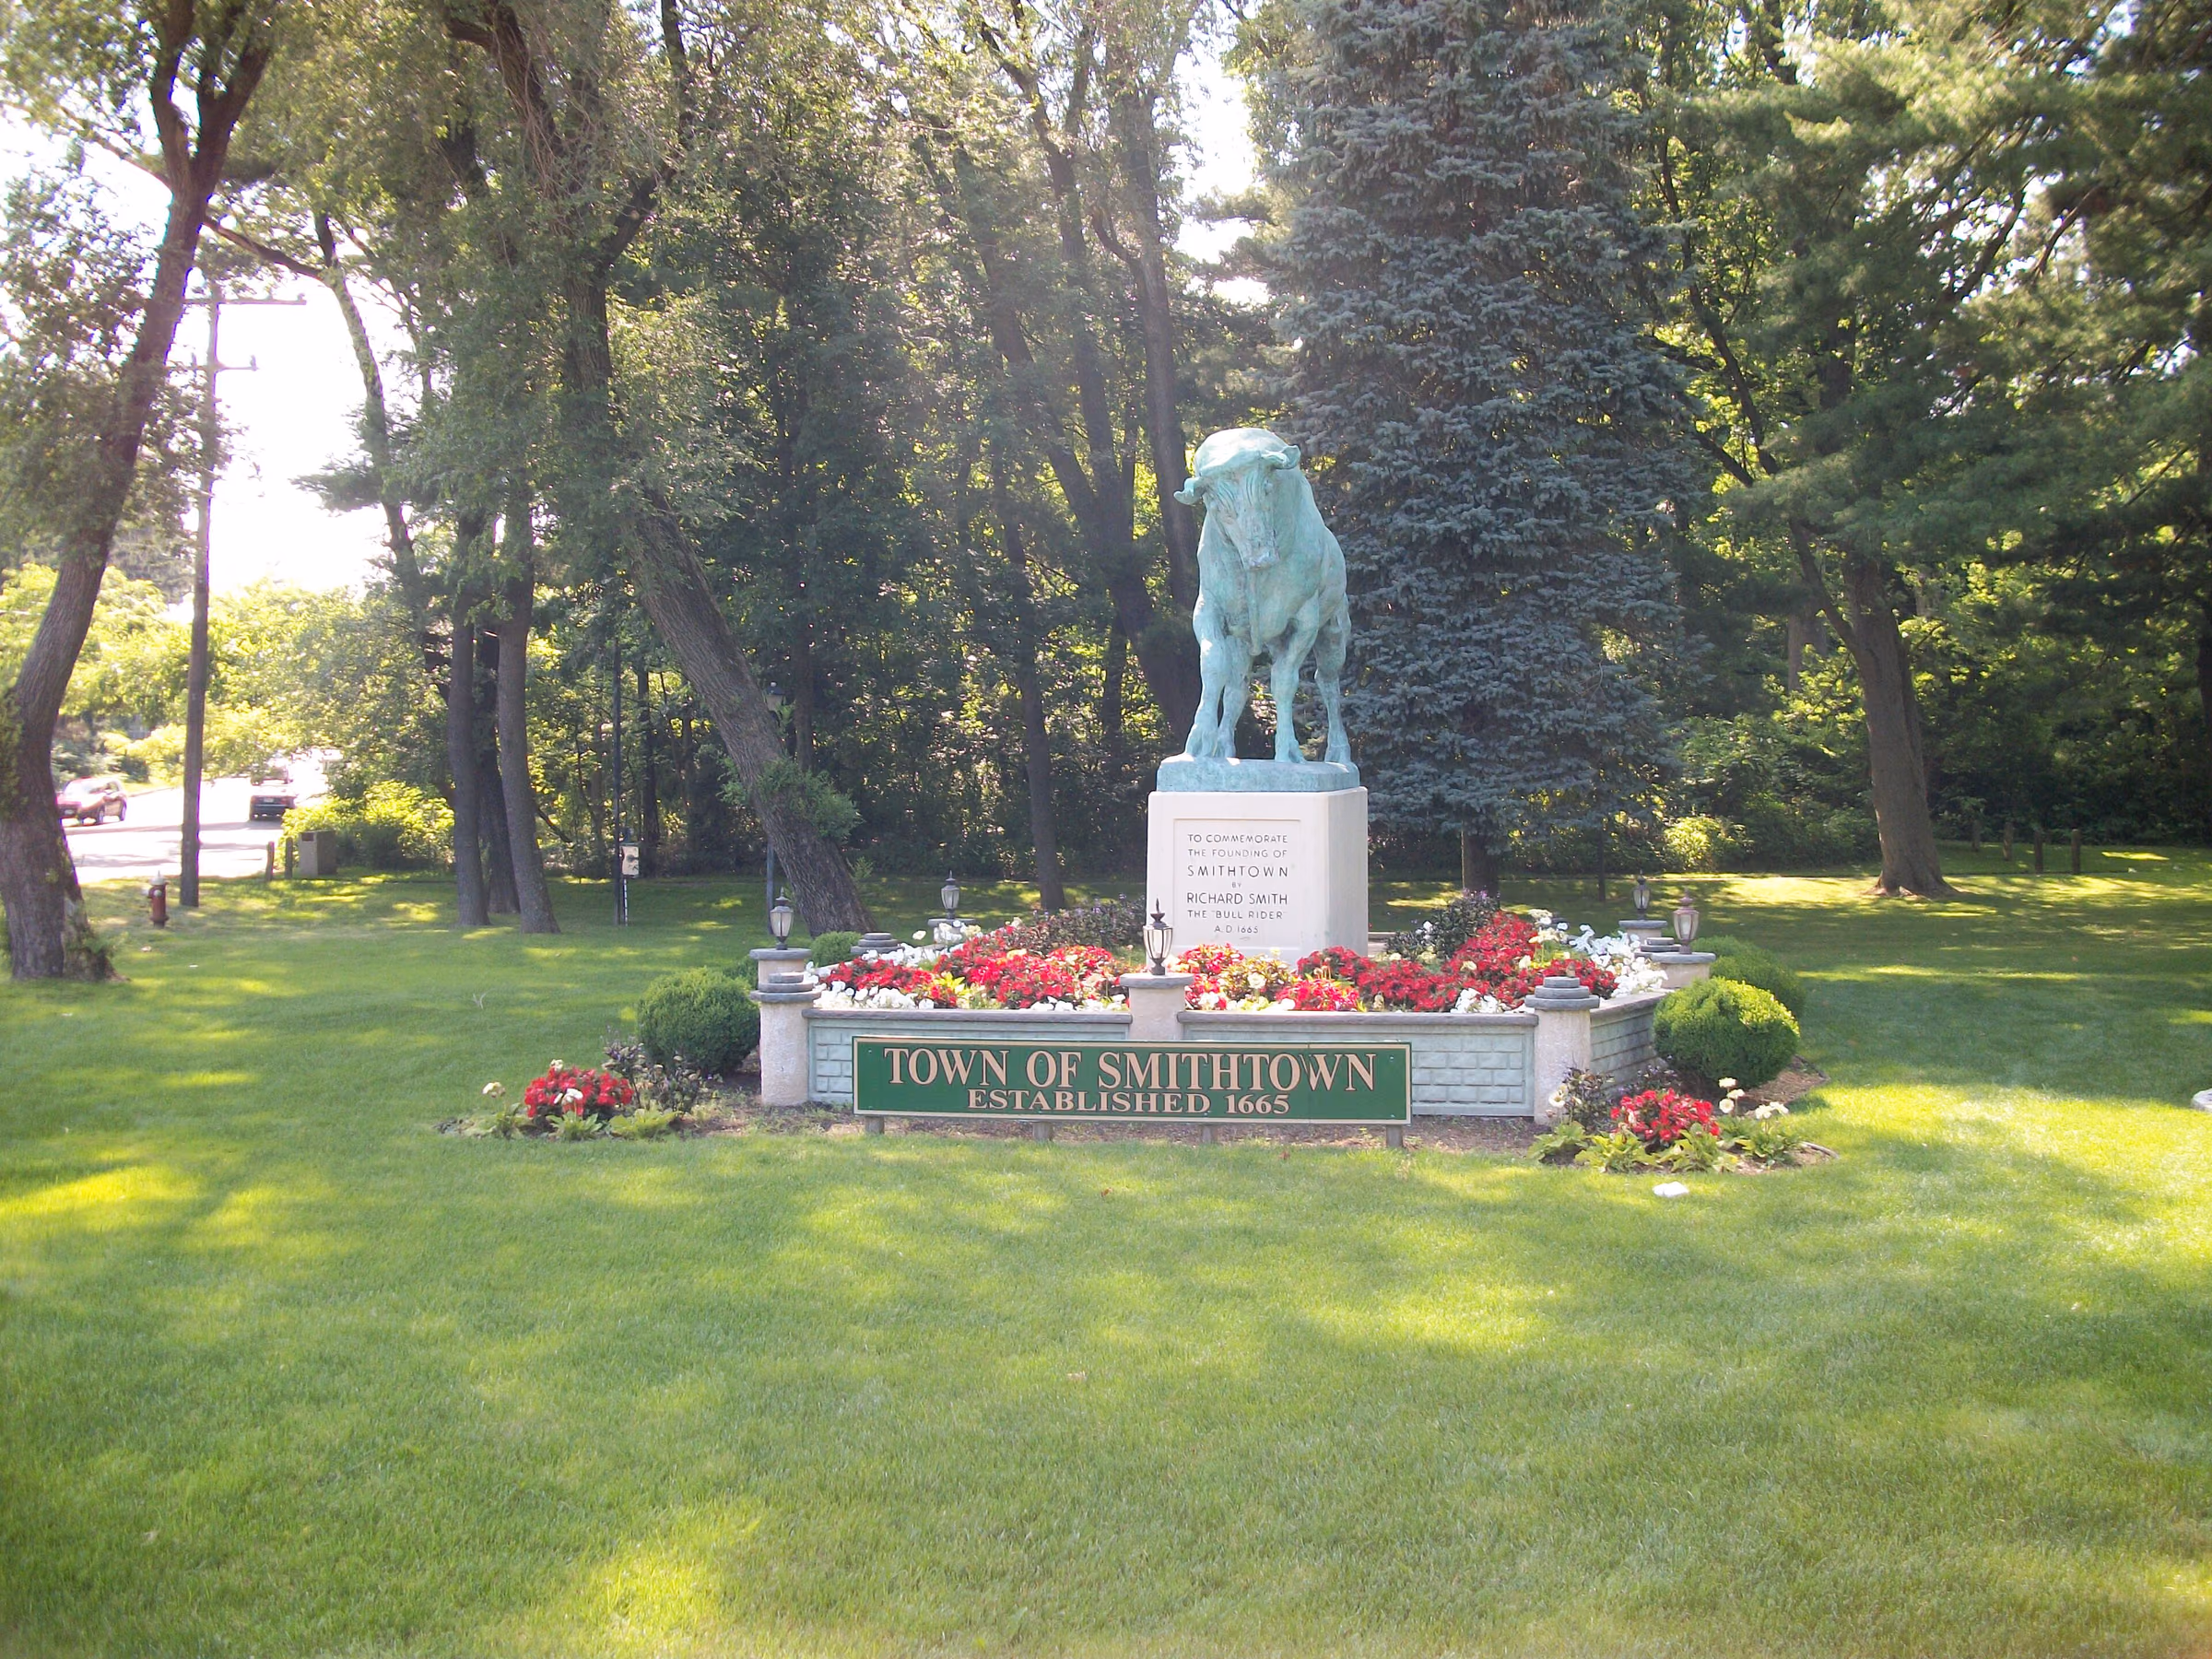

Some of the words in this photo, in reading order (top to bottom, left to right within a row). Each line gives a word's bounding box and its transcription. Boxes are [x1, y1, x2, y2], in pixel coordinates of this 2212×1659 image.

[1187, 834, 1202, 843] TO
[1206, 834, 1288, 843] COMMEMORATE
[1188, 849, 1206, 857] THE
[1212, 849, 1268, 858] FOUNDING
[1273, 849, 1288, 858] OF
[1187, 865, 1288, 877] SMITHTOWN
[1186, 892, 1243, 904] RICHARD
[1249, 893, 1288, 905] SMITH
[1187, 910, 1207, 918] THE
[1237, 925, 1259, 934] 1665
[884, 1047, 1010, 1086] TOWN
[1025, 1050, 1082, 1088] OF
[1098, 1051, 1377, 1092] SMITHTOWN
[968, 1088, 1211, 1114] ESTABLISHED
[1225, 1093, 1291, 1115] 1665
